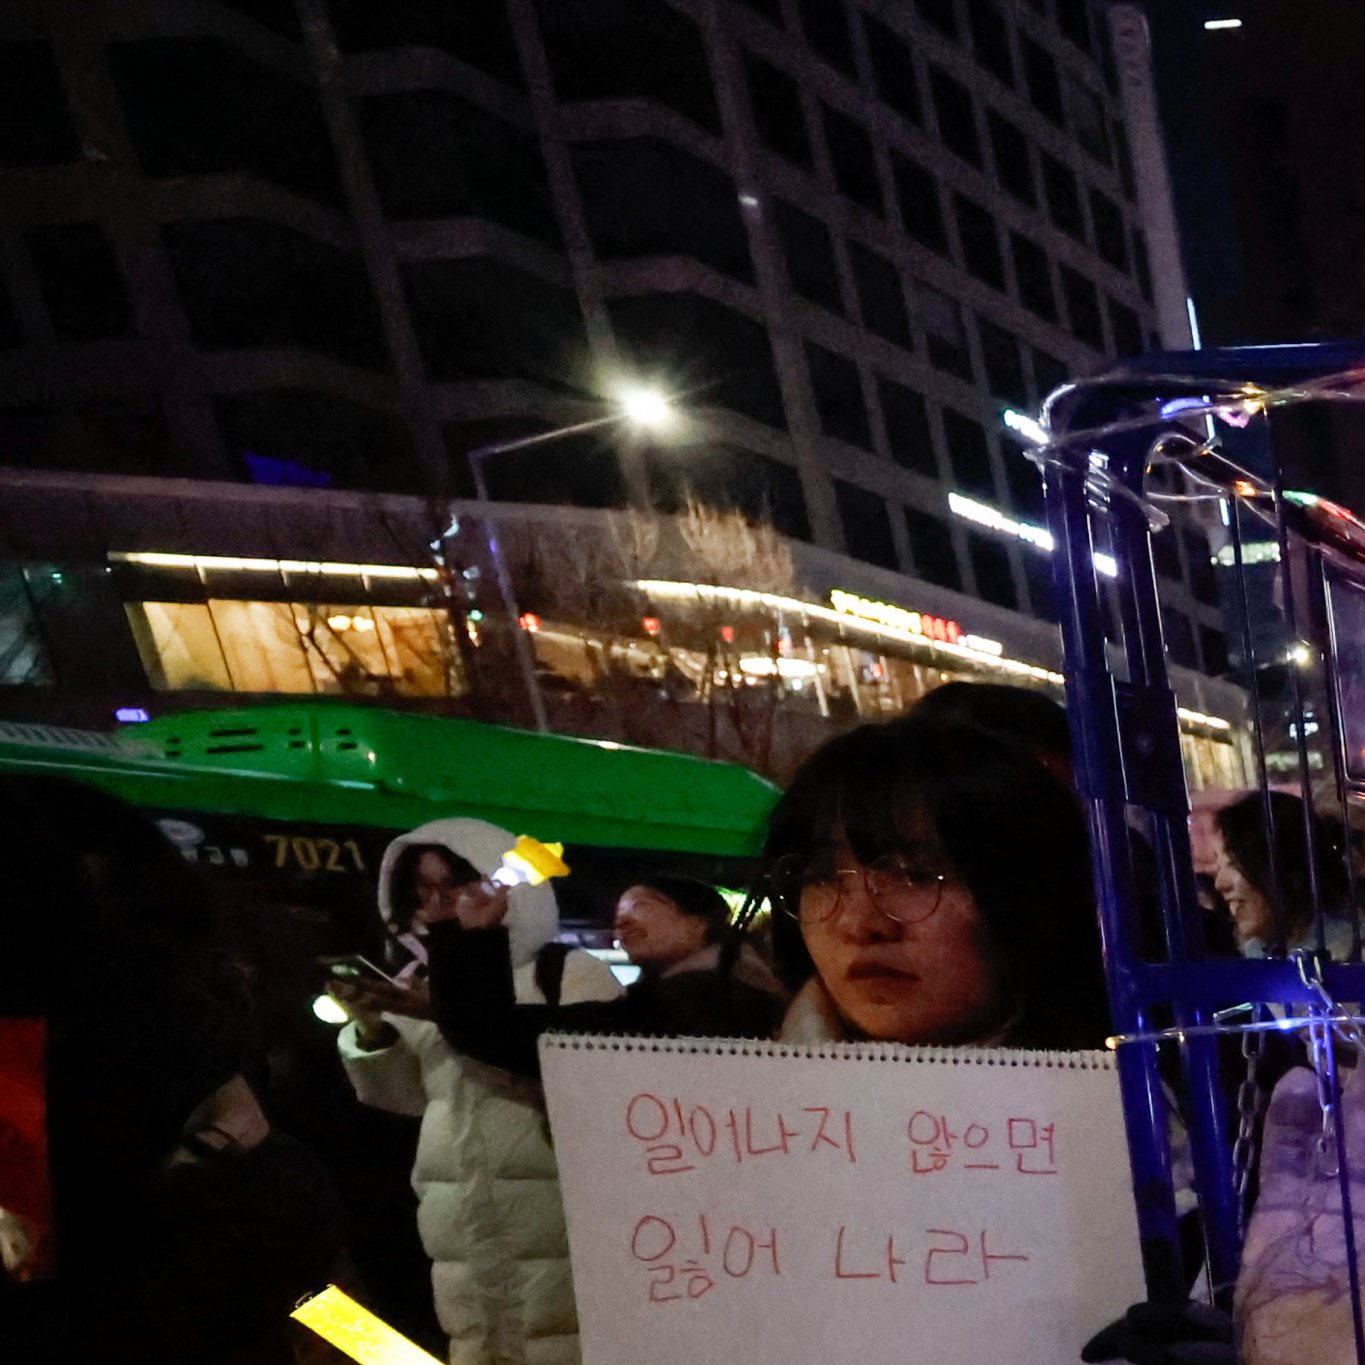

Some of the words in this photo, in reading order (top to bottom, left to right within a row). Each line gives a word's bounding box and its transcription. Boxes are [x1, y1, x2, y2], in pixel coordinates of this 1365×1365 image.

[264, 835, 364, 871] 7021
[627, 1093, 857, 1176] 일어나지
[906, 1109, 1058, 1175] 않으면
[631, 1215, 781, 1304] 잃어
